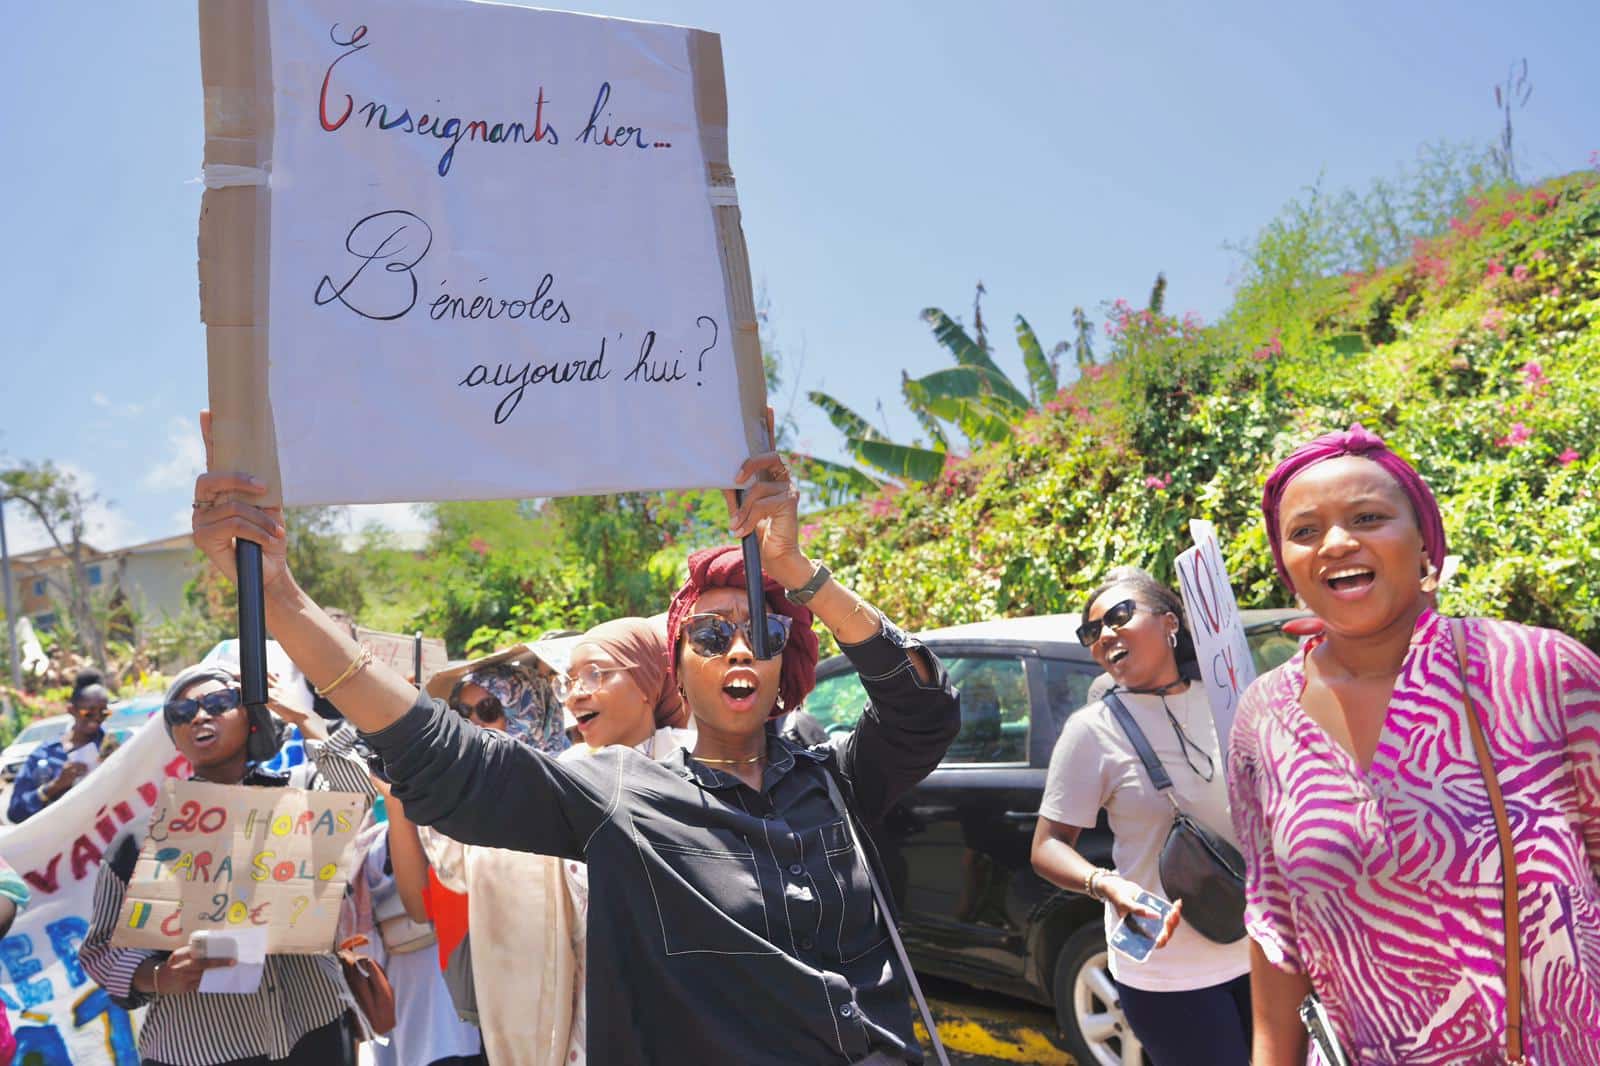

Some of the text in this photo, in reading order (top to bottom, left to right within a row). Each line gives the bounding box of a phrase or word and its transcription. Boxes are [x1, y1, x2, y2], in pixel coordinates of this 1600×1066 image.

[319, 23, 559, 177] Enseignants
[314, 210, 571, 323] Bénévoles
[245, 807, 353, 840] HORAS
[154, 847, 337, 882] PARA SOLO
